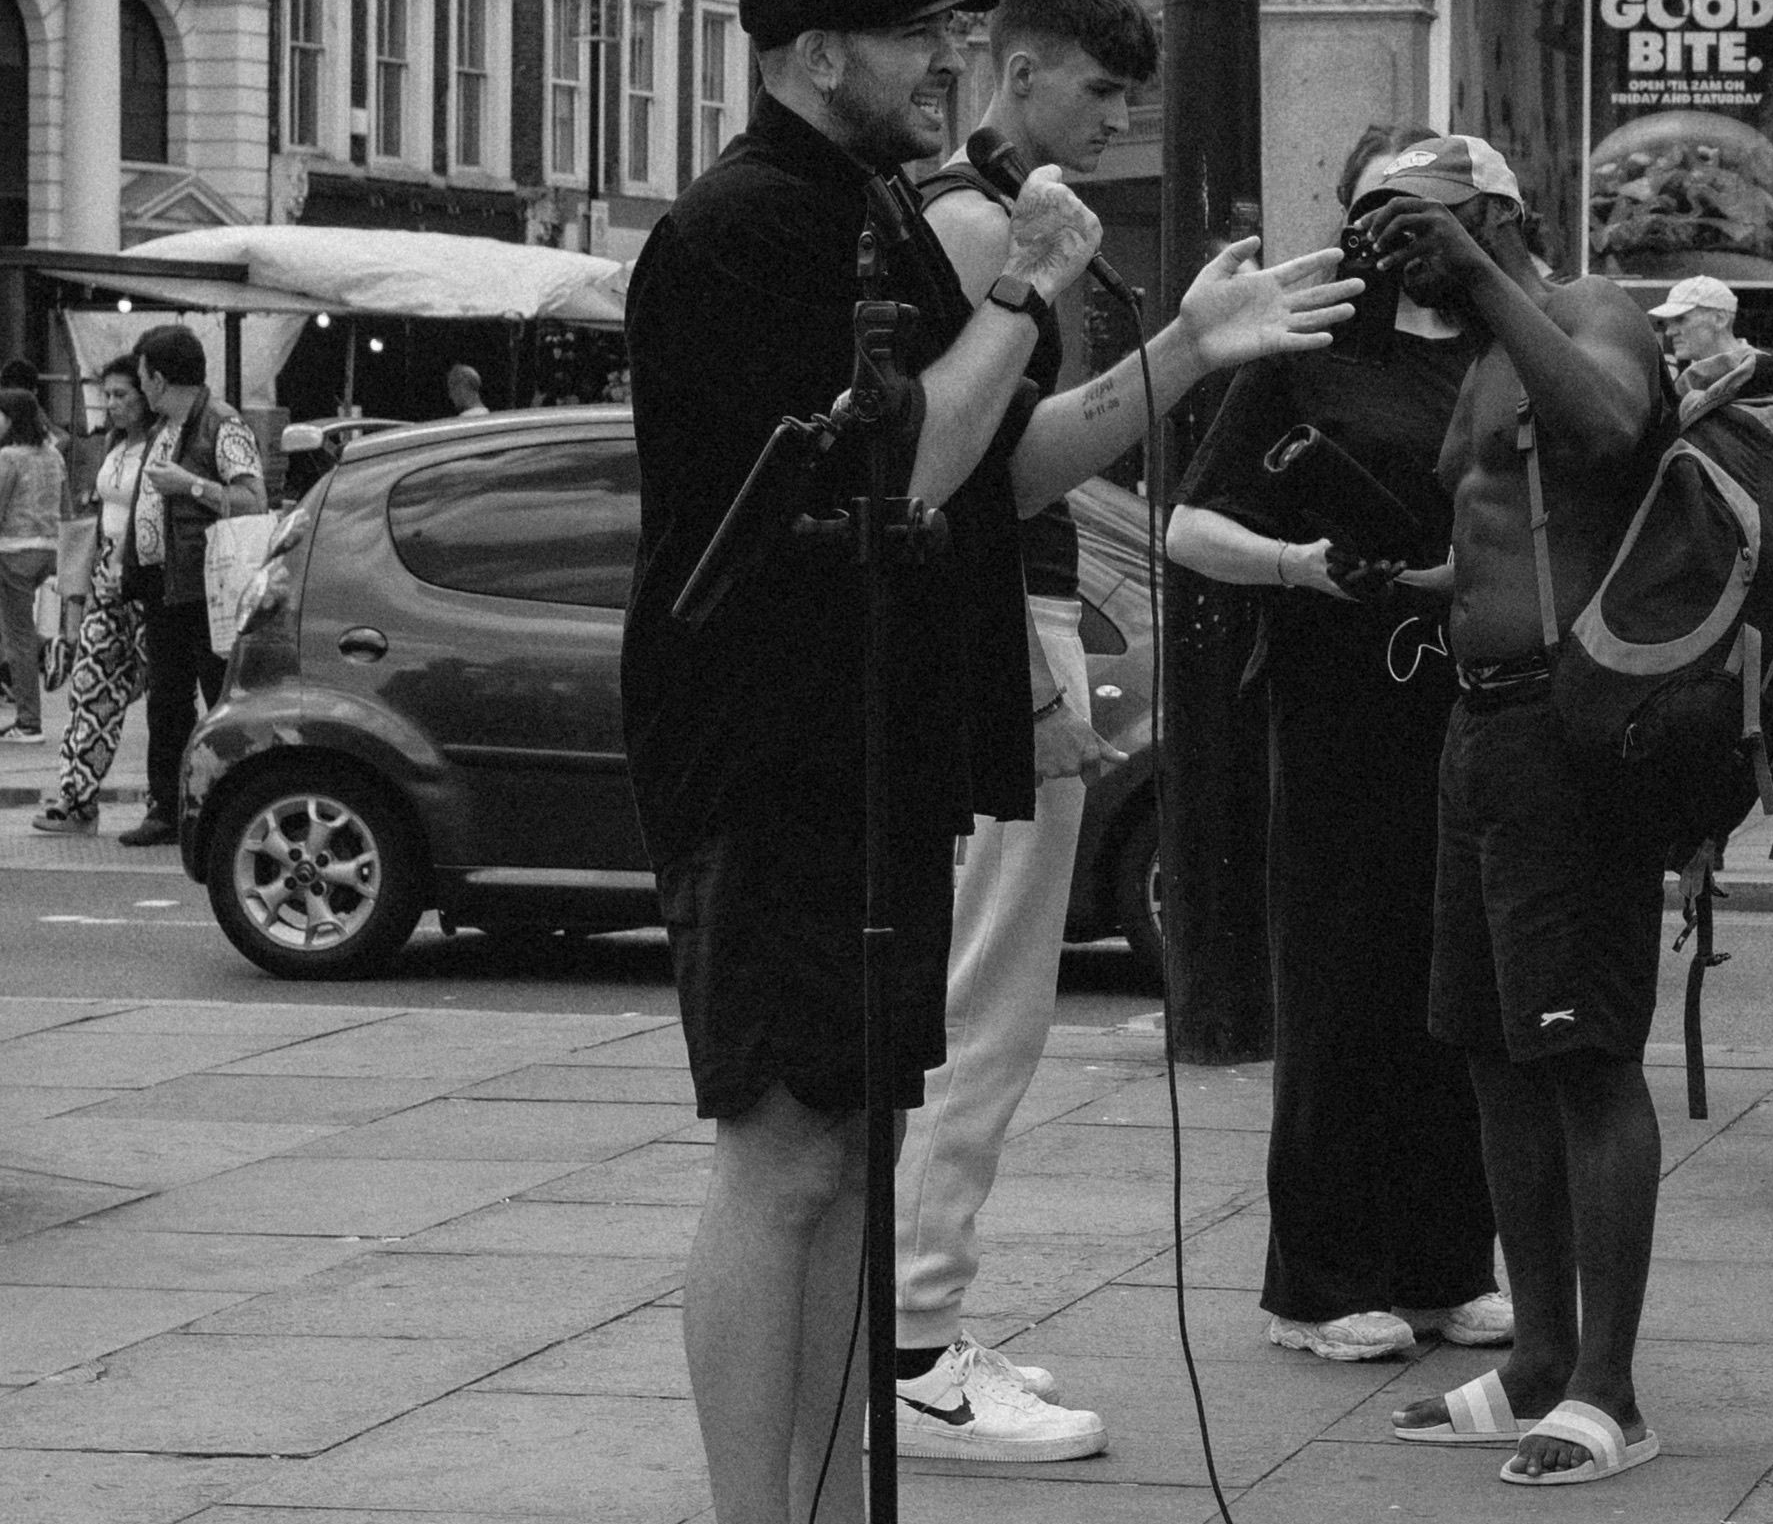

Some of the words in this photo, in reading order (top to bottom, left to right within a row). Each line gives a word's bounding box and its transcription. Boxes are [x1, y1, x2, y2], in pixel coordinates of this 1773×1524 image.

[1628, 31, 1763, 73] BITE.
[1628, 80, 1665, 92] OPEN
[1690, 80, 1722, 92] 2AM
[1724, 80, 1745, 92] ON
[1610, 93, 1659, 105] FRIDAY
[1661, 93, 1690, 105] AND
[1692, 93, 1763, 105] SATURDAY
